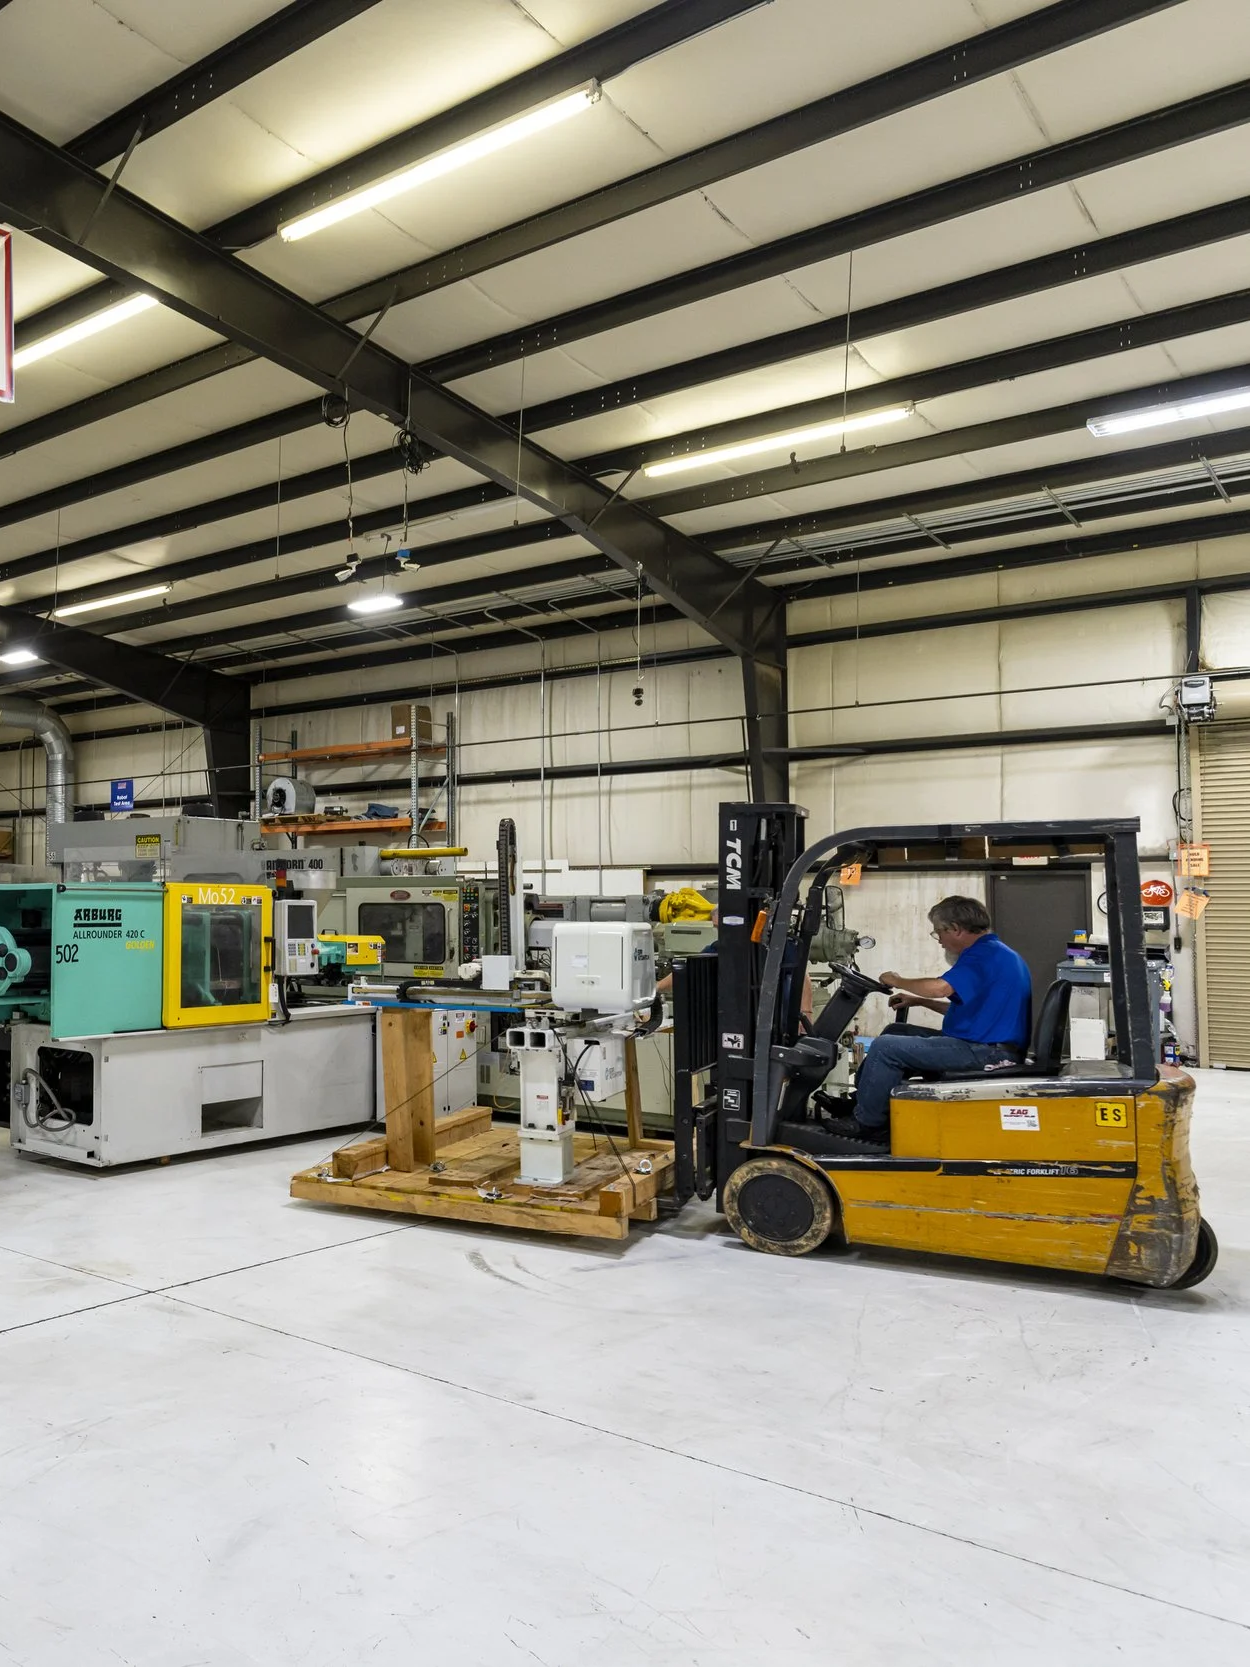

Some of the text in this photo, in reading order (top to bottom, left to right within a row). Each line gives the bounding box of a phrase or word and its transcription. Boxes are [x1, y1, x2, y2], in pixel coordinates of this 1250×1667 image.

[308, 859, 323, 869] 400
[726, 838, 742, 890] TCM
[198, 887, 235, 905] Mo52
[74, 908, 122, 921] ARBURG
[73, 930, 145, 939] ALLROUNDER 420 C
[125, 941, 155, 950] GOLDEN
[56, 944, 79, 964] 502
